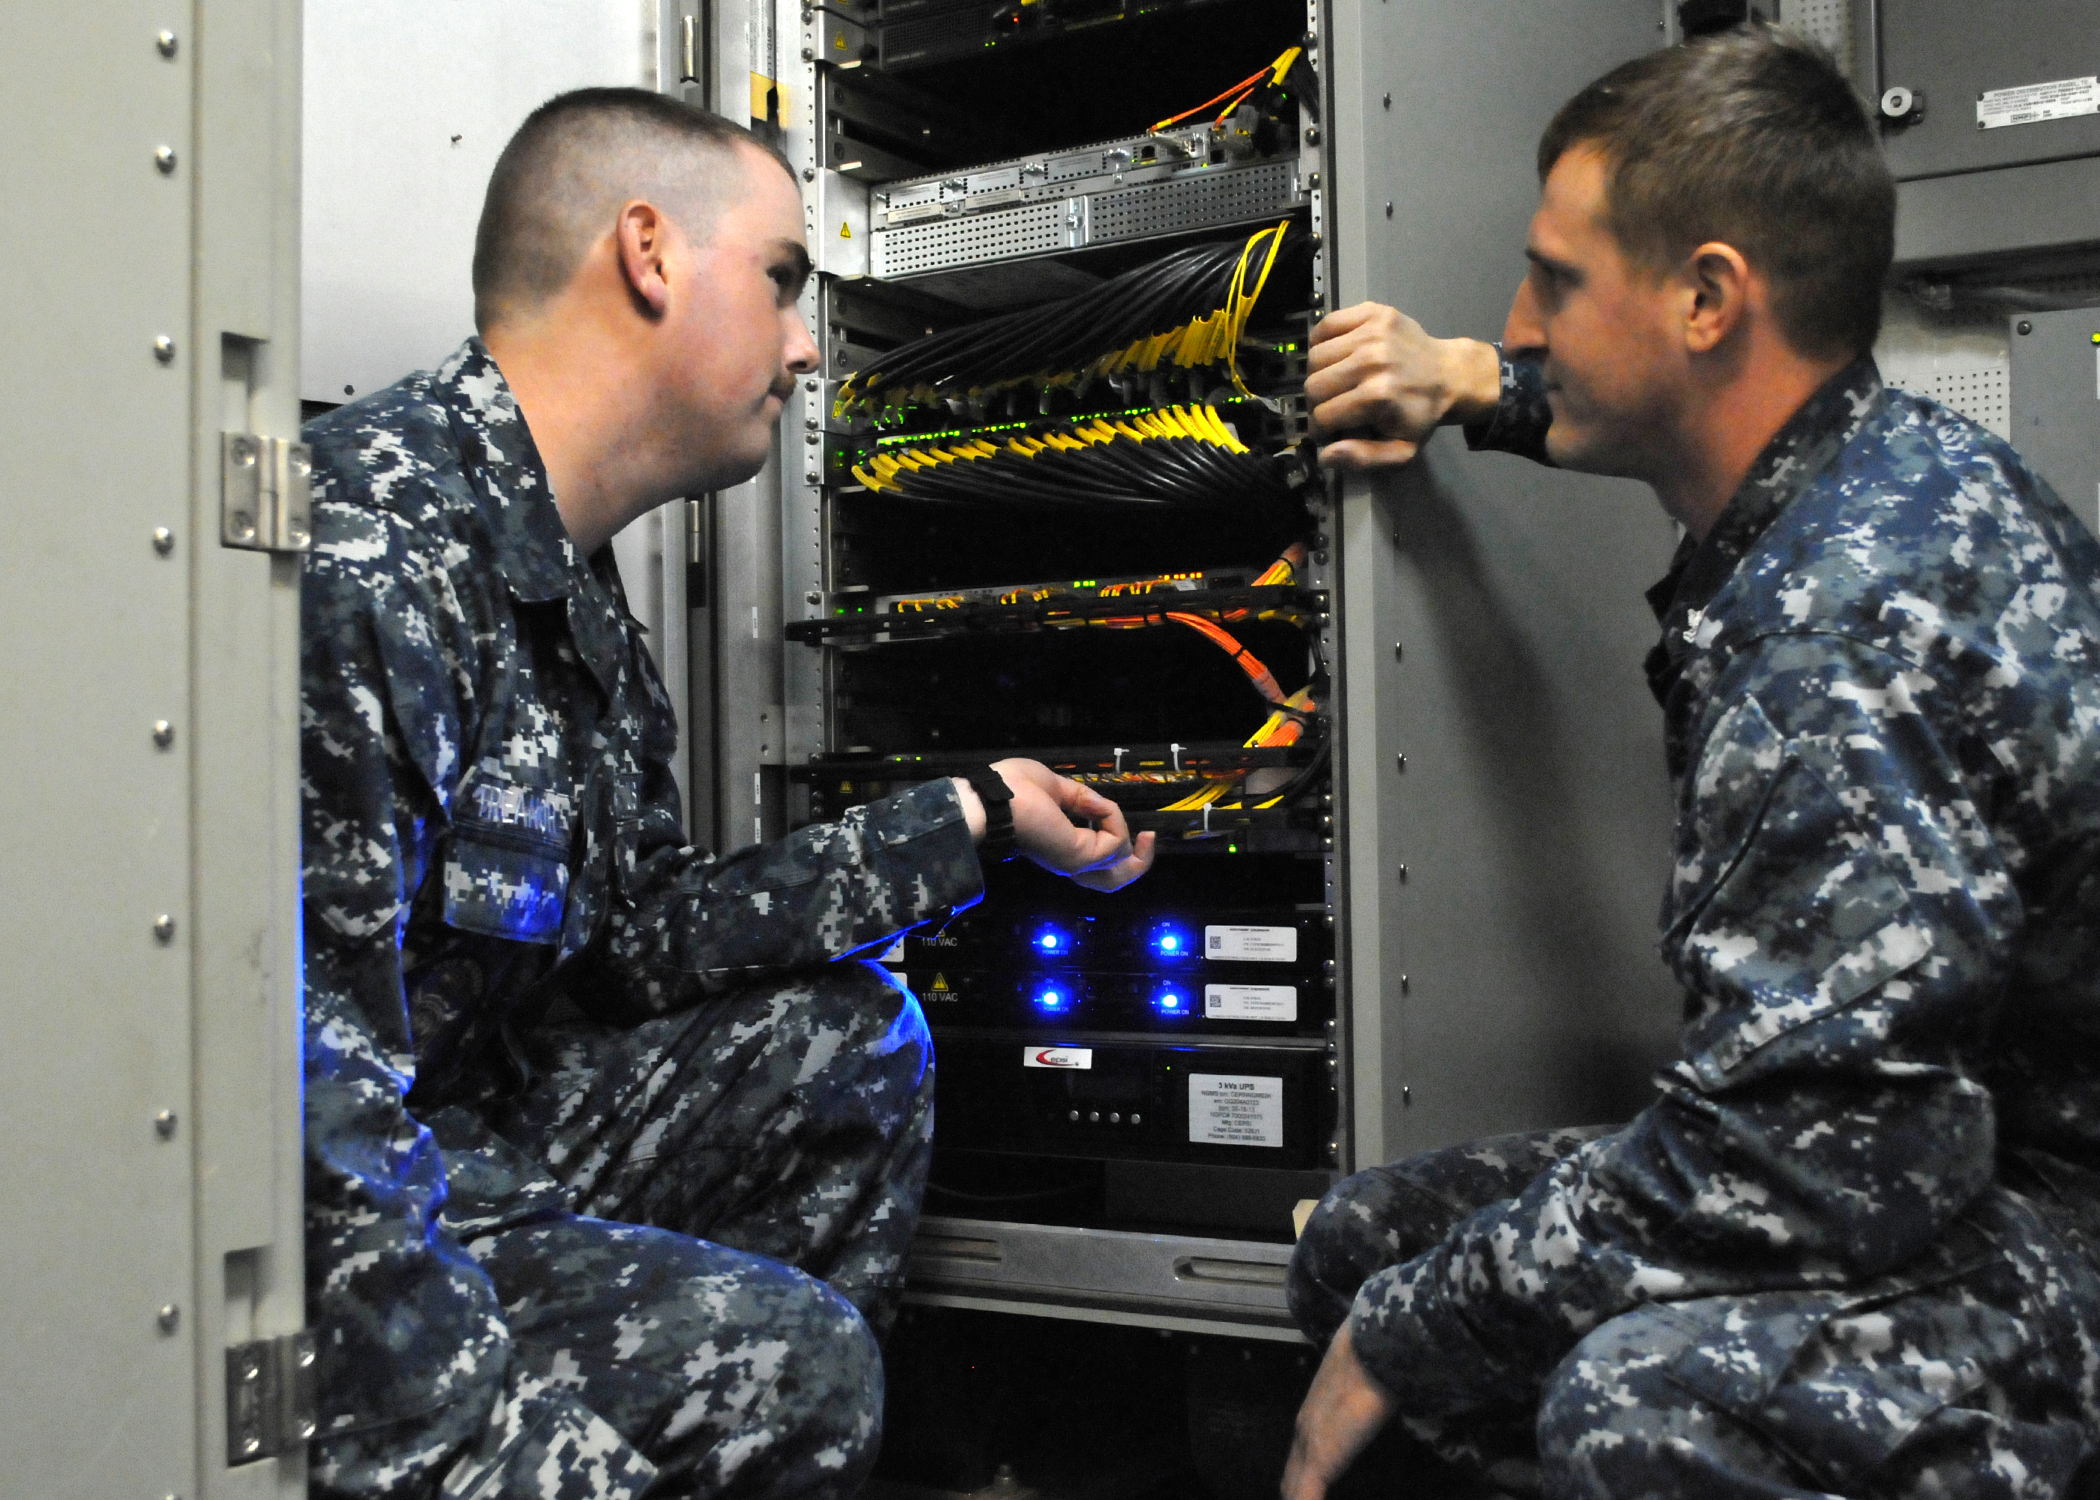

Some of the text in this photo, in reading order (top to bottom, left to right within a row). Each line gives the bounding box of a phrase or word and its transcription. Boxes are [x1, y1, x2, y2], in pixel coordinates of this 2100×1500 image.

[922, 938, 958, 947] 110 VAC
[922, 993, 958, 1002] 110 VAC
